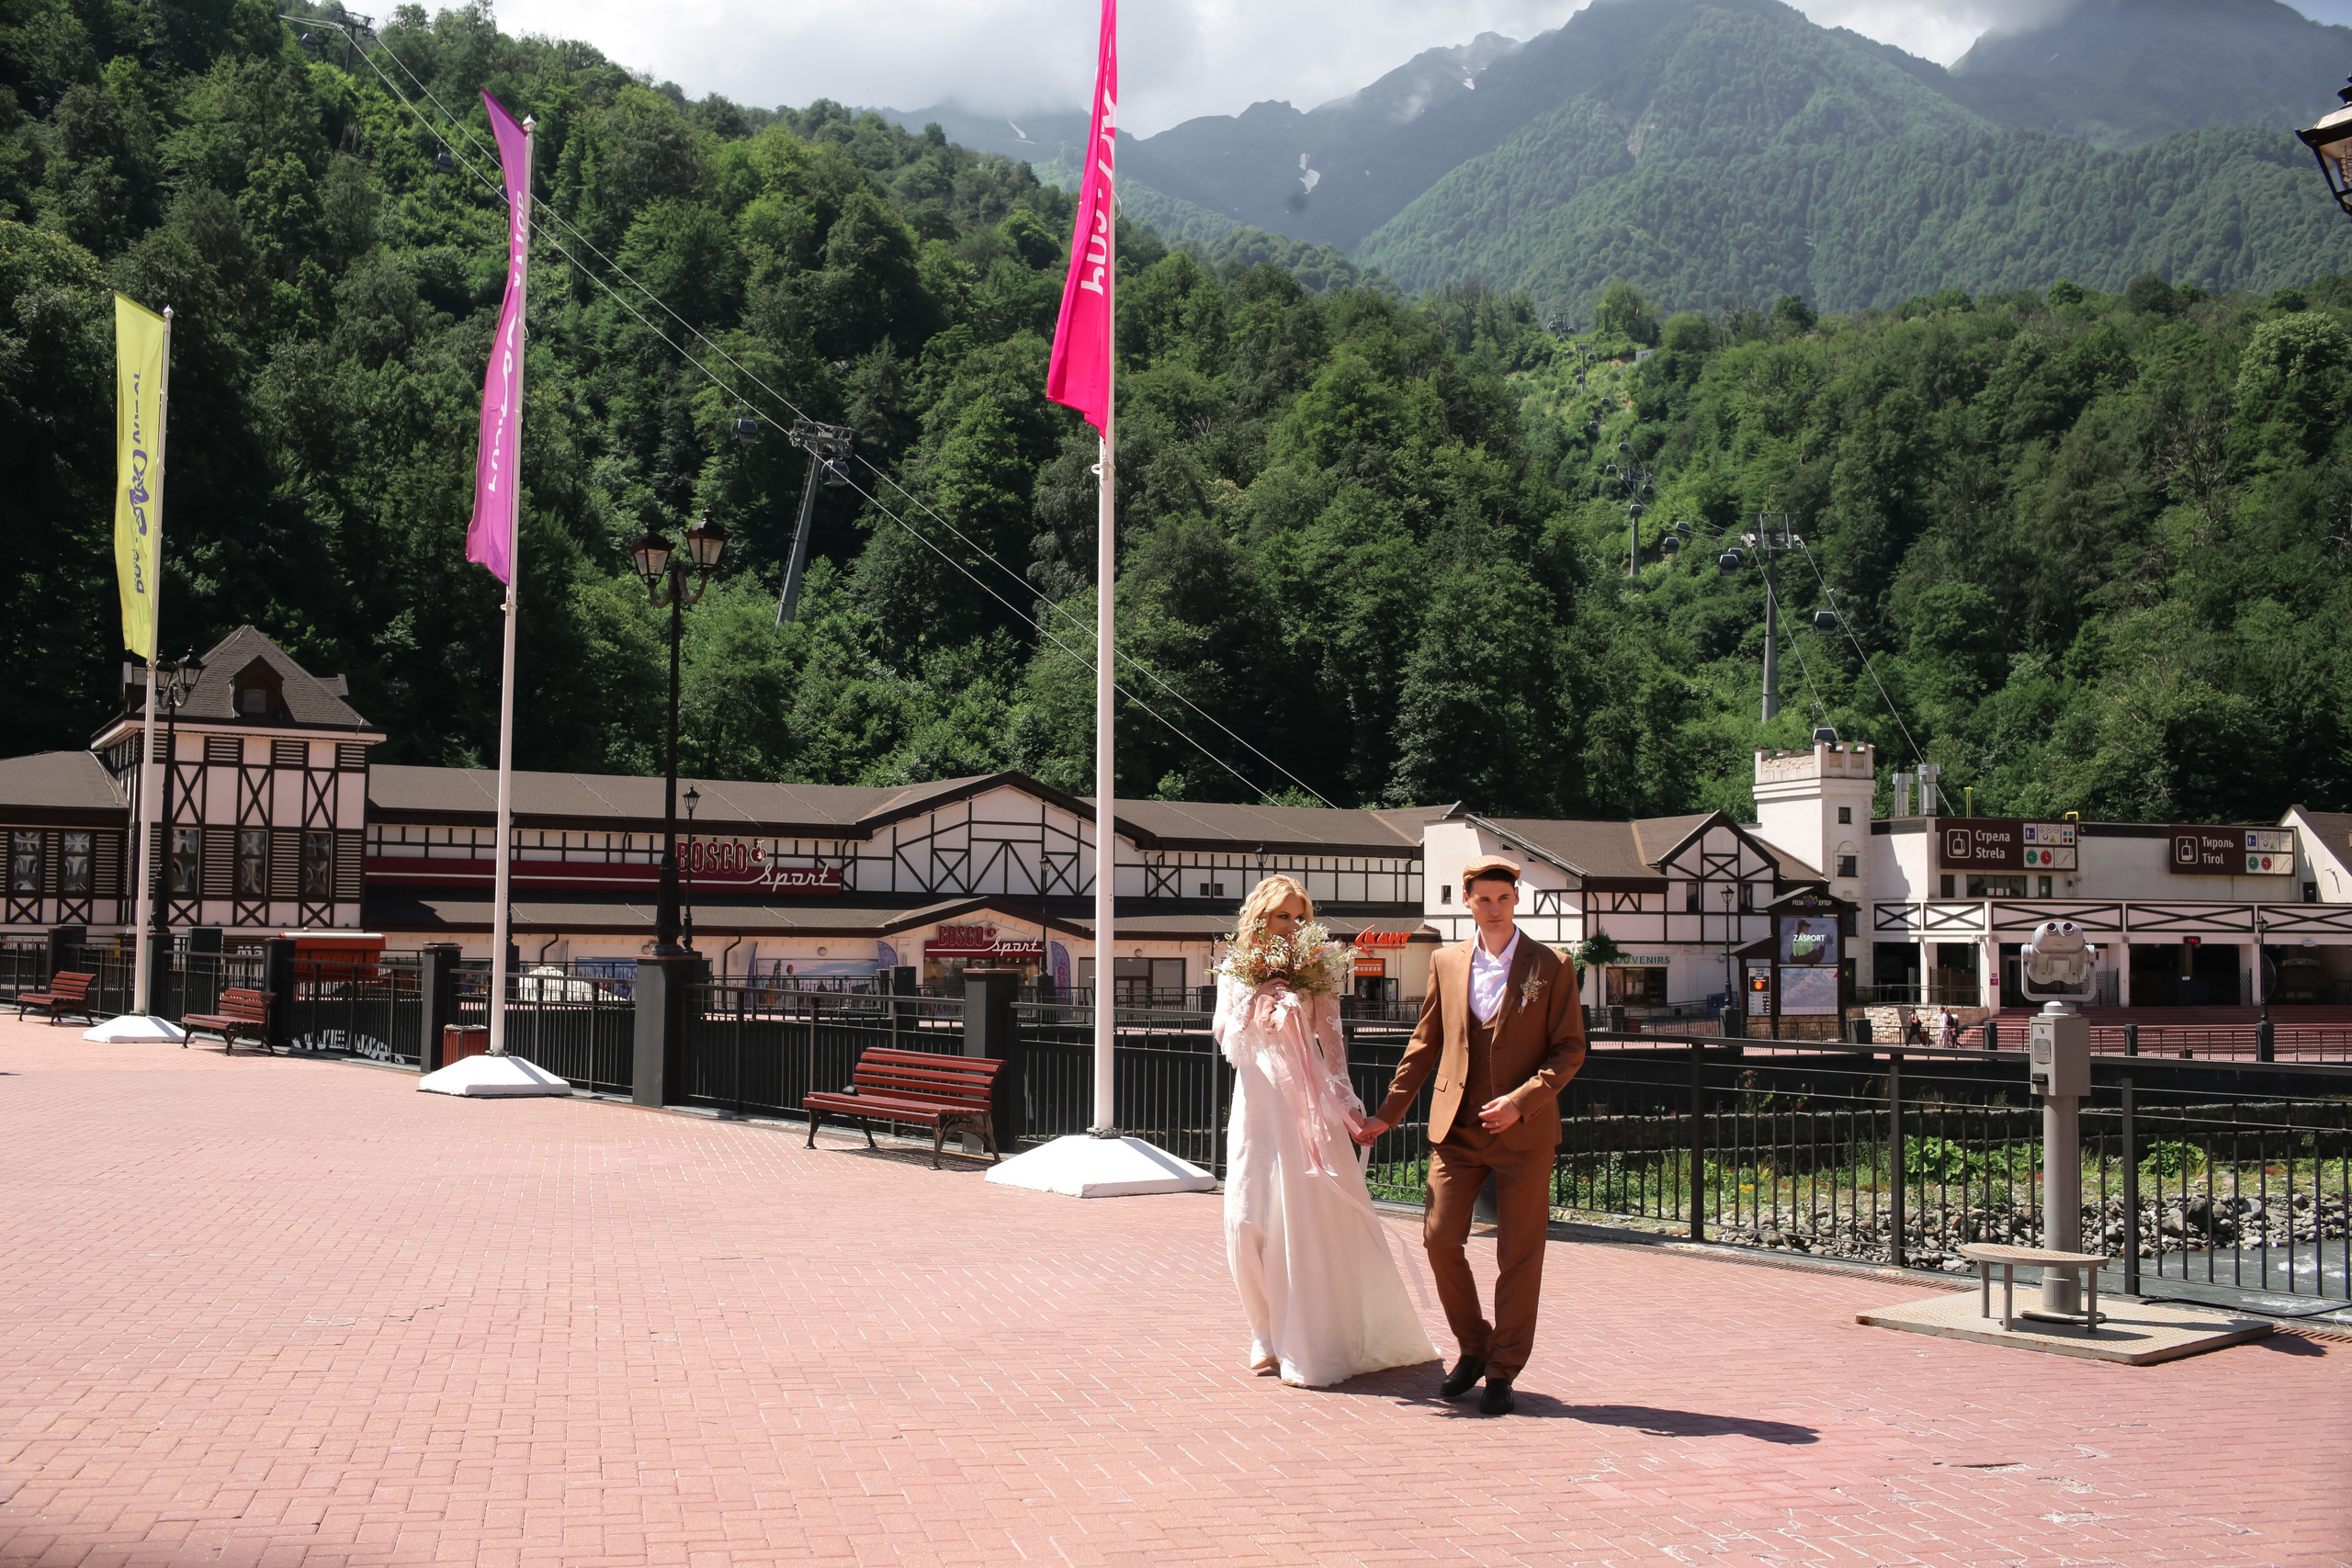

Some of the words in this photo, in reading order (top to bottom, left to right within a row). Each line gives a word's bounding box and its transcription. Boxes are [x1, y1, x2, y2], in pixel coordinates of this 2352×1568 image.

[1975, 829, 2010, 844] Стрела
[2201, 836, 2234, 850] Тироль
[675, 840, 749, 874] BOSCO
[1975, 847, 2006, 859] Strela
[2201, 853, 2224, 864] Tirol
[938, 925, 984, 947] BOSCO
[1792, 934, 1826, 942] ZASPORT
[1612, 955, 1670, 964] OUVENIRS
